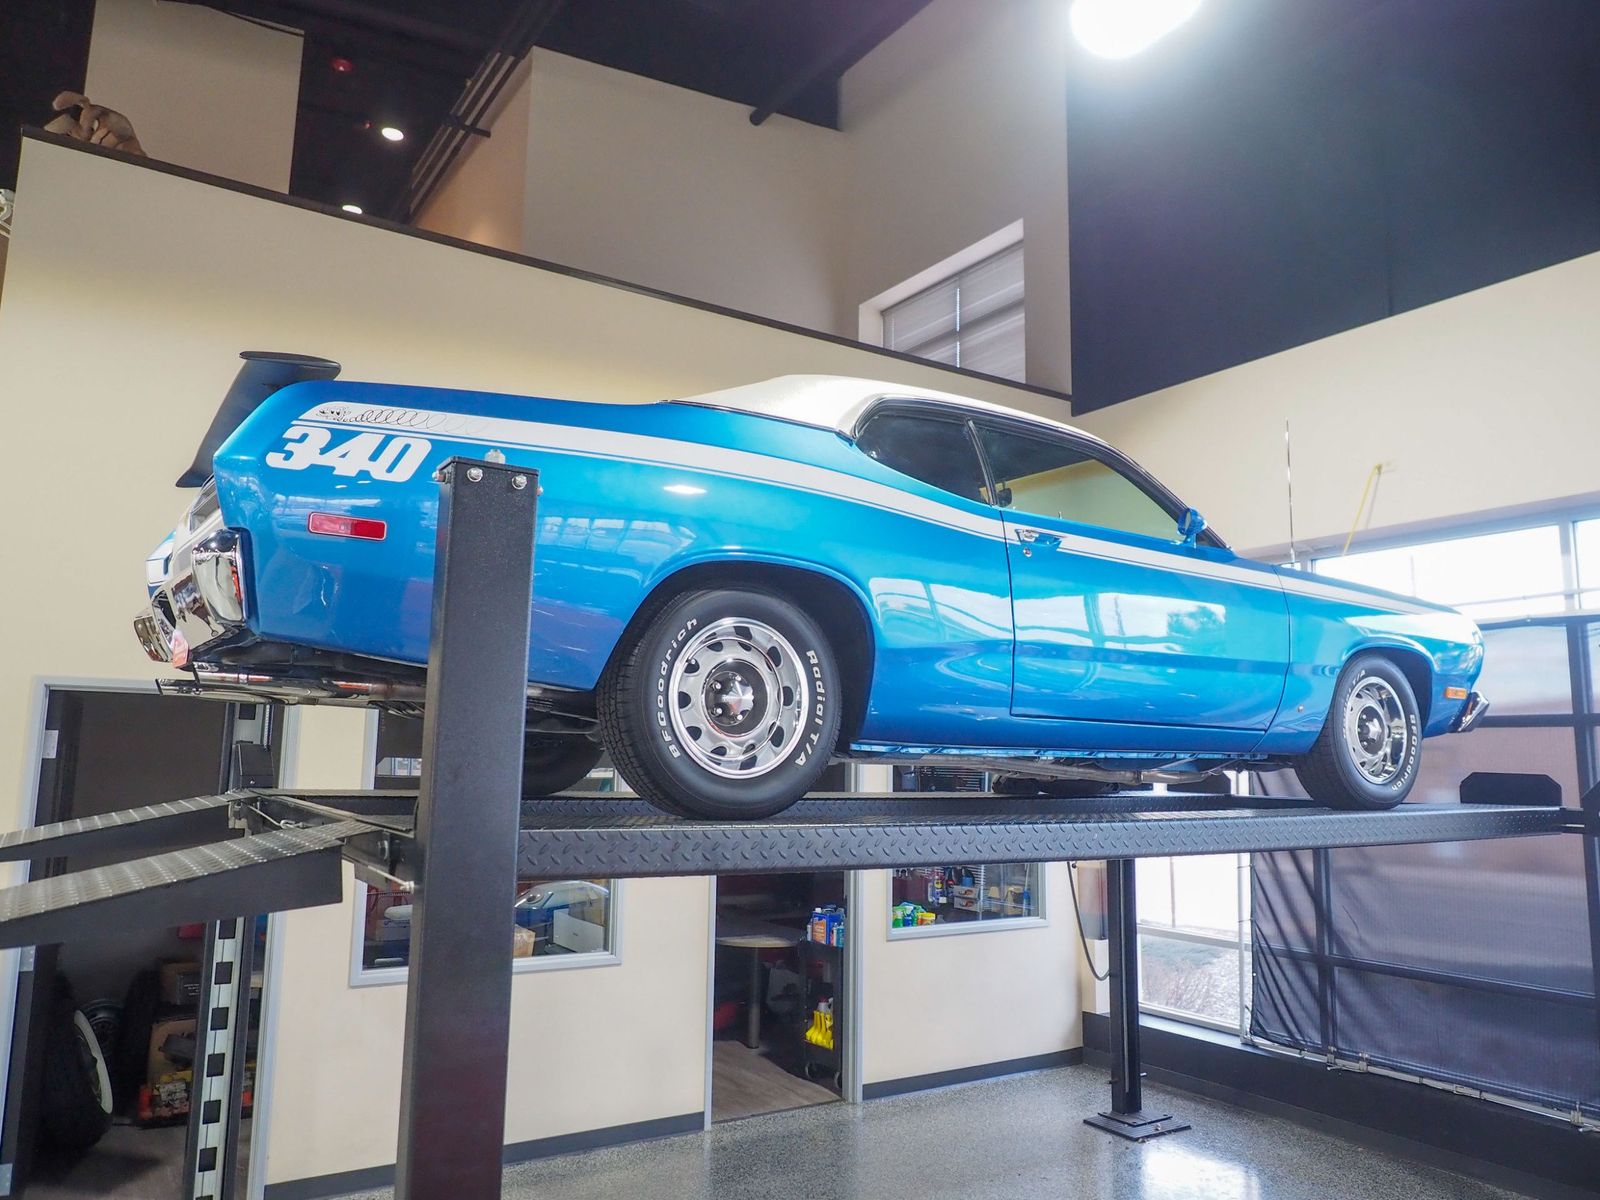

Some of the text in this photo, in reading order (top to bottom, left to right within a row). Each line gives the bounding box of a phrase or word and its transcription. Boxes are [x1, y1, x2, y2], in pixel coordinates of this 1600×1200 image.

[265, 426, 432, 483] 340
[656, 617, 698, 759] BFGoodrich
[794, 649, 826, 766] Radial T/A
[1391, 714, 1418, 791] BFGoodrich
